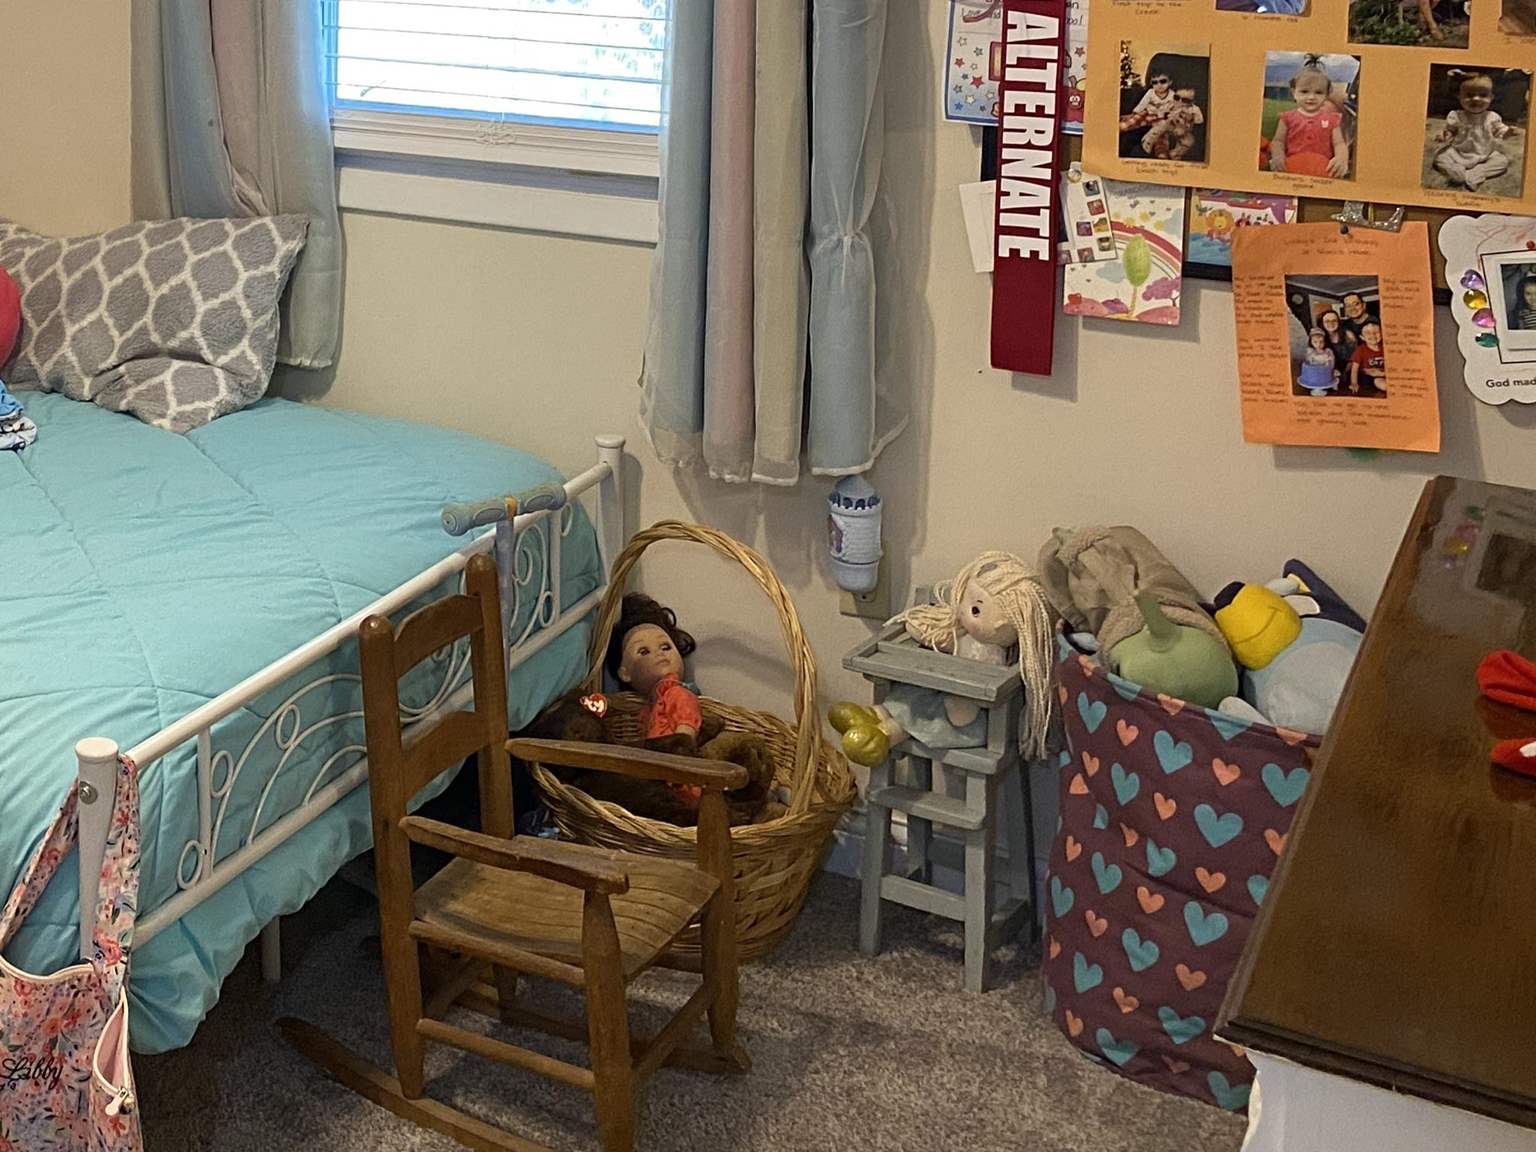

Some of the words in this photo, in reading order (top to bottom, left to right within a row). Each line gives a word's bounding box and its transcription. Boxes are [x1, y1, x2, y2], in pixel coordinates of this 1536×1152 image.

[998, 10, 1060, 261] ALTERNATE
[1486, 378, 1510, 388] God
[0, 1056, 64, 1091] Libby
